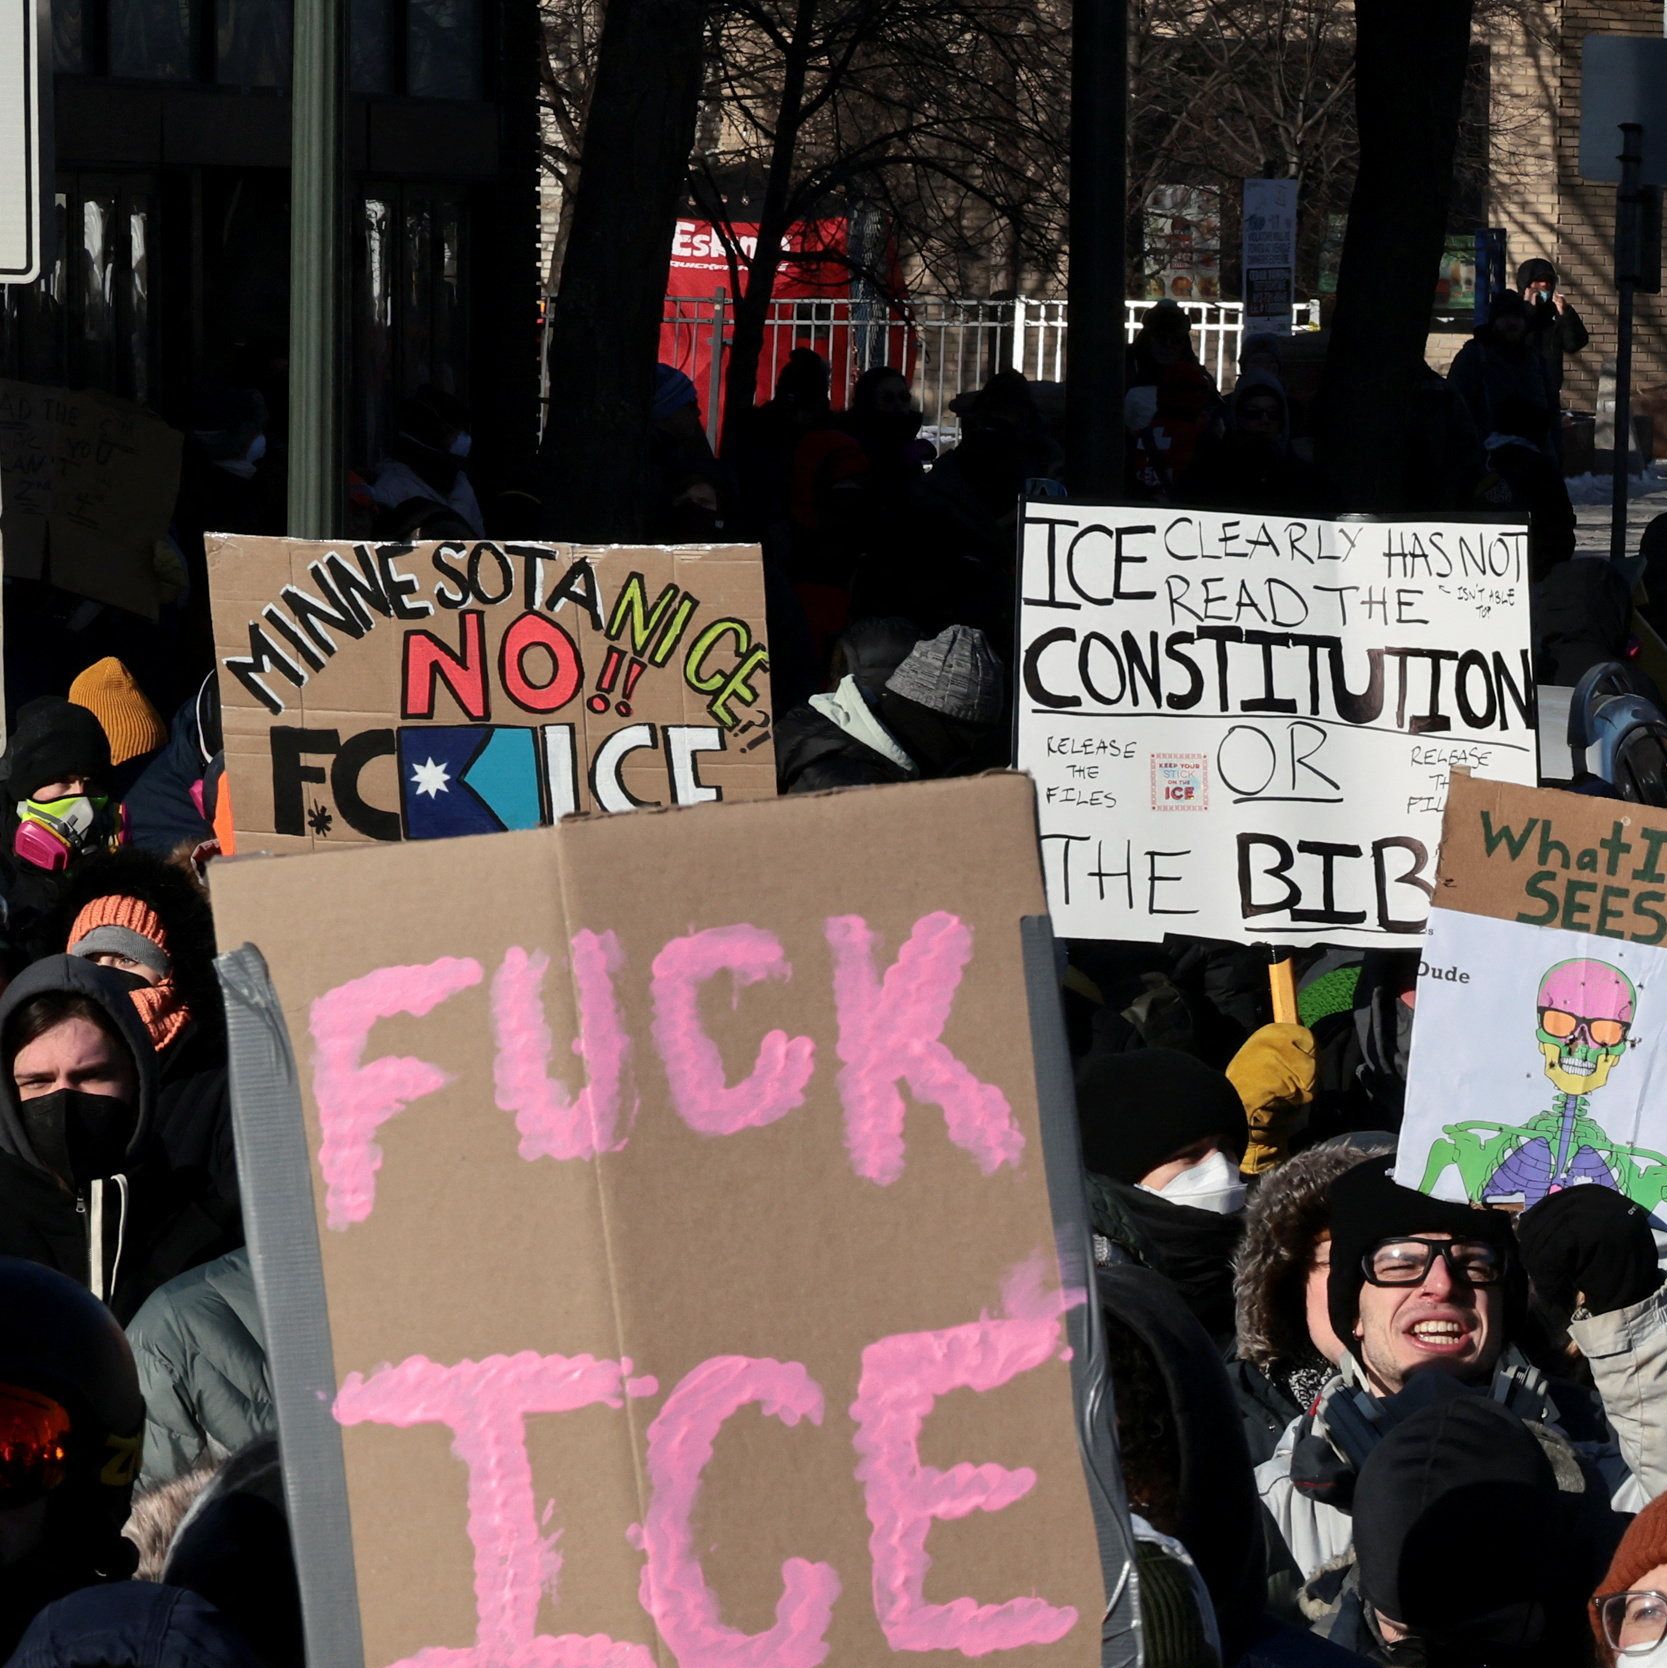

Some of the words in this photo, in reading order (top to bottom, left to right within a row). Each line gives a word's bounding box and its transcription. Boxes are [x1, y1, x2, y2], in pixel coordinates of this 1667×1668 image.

[1023, 517, 1177, 612] ICE
[1163, 517, 1364, 569] CLEARLY
[1382, 527, 1453, 578] HAS
[1457, 531, 1528, 584] NOT
[223, 543, 607, 715] MINNESOTA
[1165, 573, 1326, 629] READ
[1312, 583, 1430, 625] THE
[1022, 624, 1535, 734] CONSTITUTION
[540, 721, 733, 828] ICE
[1047, 736, 1152, 767] RELEASE
[1066, 763, 1103, 783] THE
[1163, 769, 1196, 779] STICK
[1217, 721, 1346, 797] OR
[1410, 745, 1493, 771] RELEASE
[1429, 773, 1450, 791] TH
[1047, 784, 1119, 811] FILES
[1165, 786, 1195, 801] ICE
[1407, 795, 1446, 815] FIL
[1038, 834, 1206, 916] THE
[1480, 810, 1632, 878] What
[1237, 832, 1436, 933] BIB
[312, 910, 1026, 1234] FUCK
